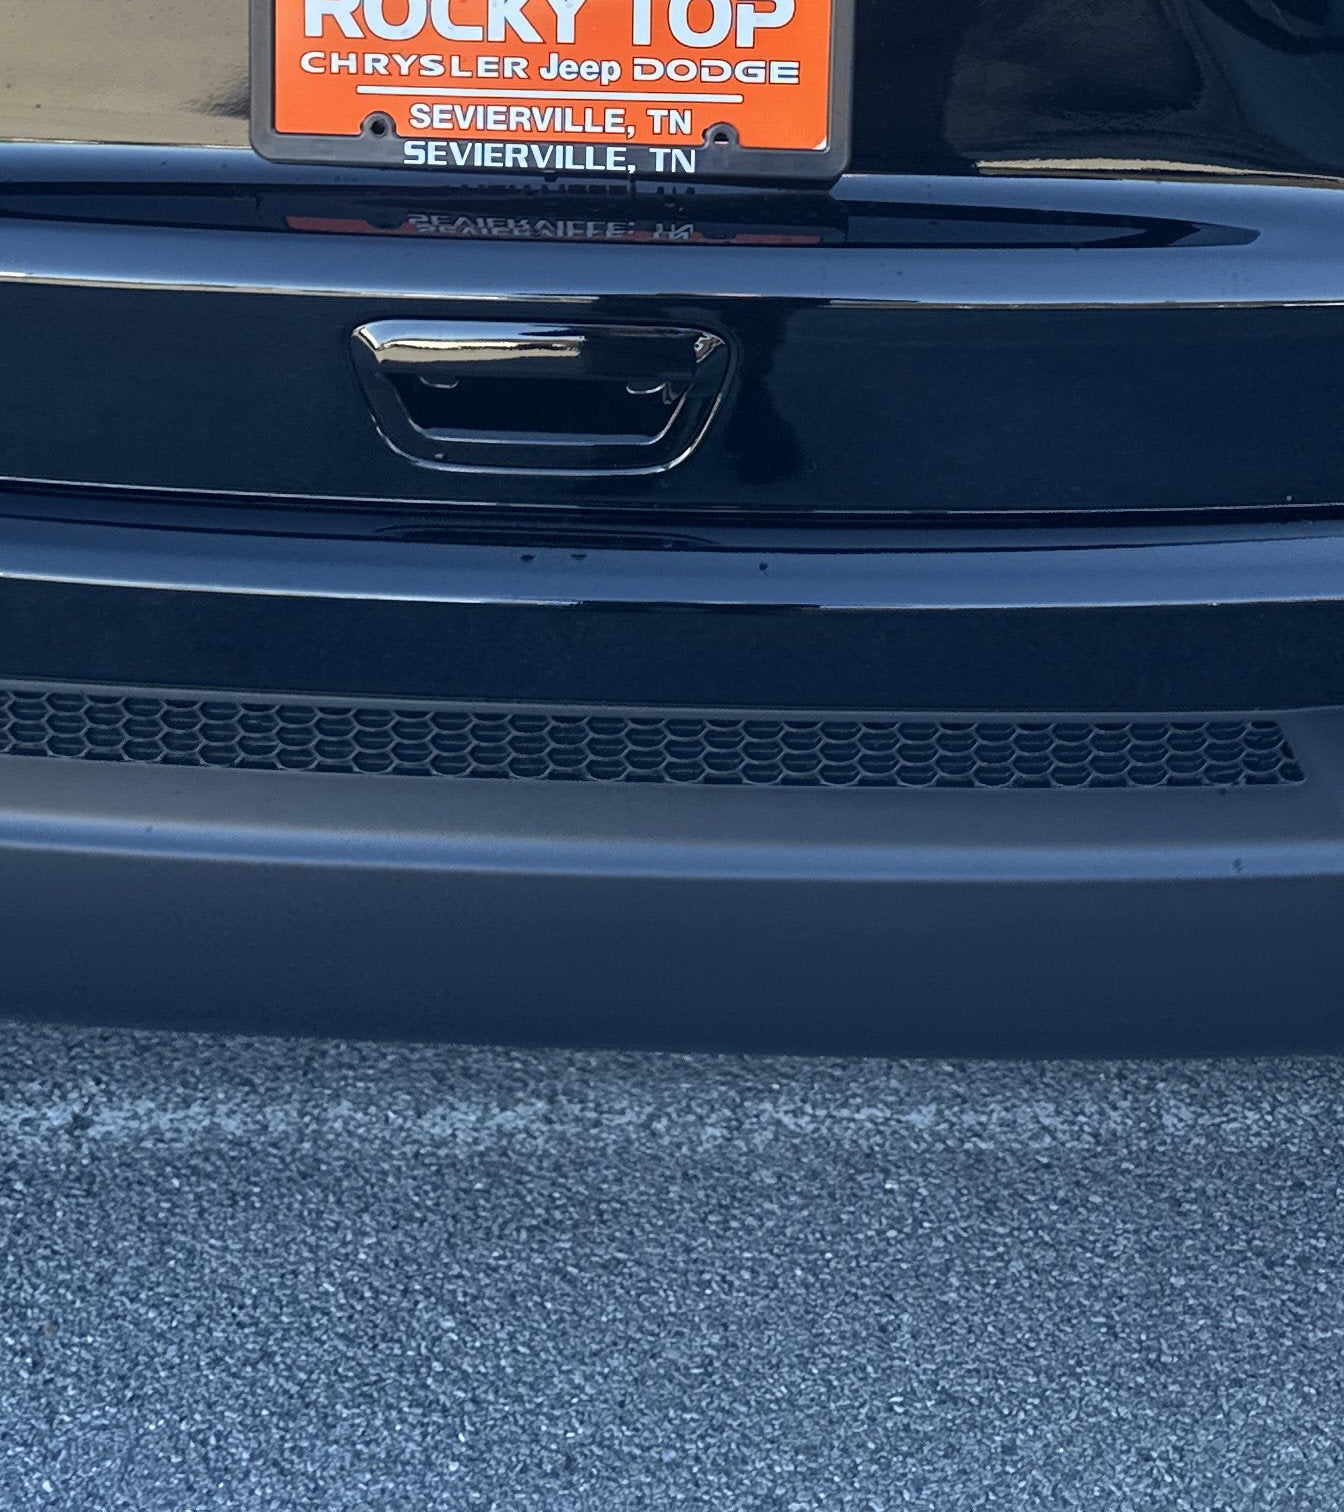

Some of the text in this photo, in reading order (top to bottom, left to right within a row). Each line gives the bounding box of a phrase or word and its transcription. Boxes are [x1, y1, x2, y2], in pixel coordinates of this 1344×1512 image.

[300, 49, 801, 86] CHRYSLER Jeep DODGE
[408, 102, 693, 140] SEVIERVILLE, TN
[402, 140, 696, 174] SEVIERVILLE, TN
